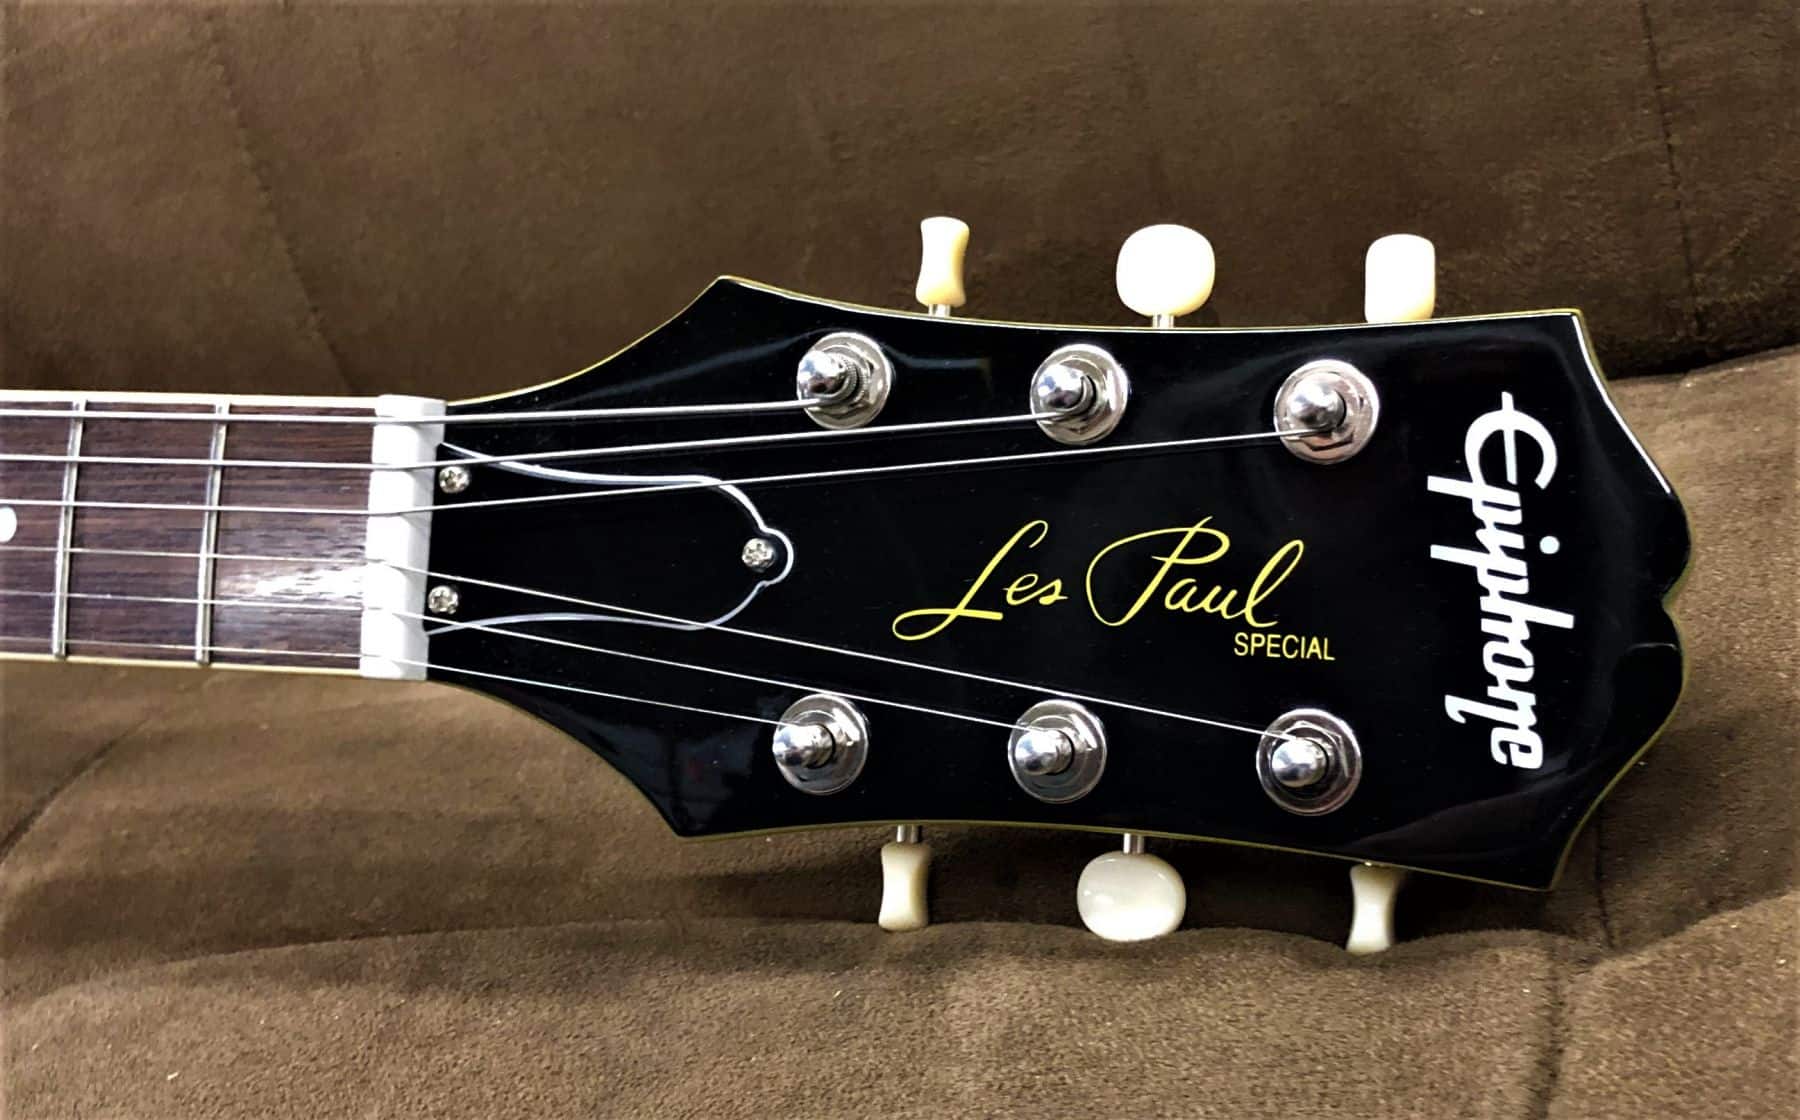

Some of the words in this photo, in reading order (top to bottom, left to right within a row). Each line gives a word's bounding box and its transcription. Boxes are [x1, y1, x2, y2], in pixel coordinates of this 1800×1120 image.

[892, 520, 1068, 640] Les
[1086, 516, 1304, 628] Paul
[1427, 391, 1575, 770] Epiphone
[1233, 632, 1336, 661] SPECIAL
